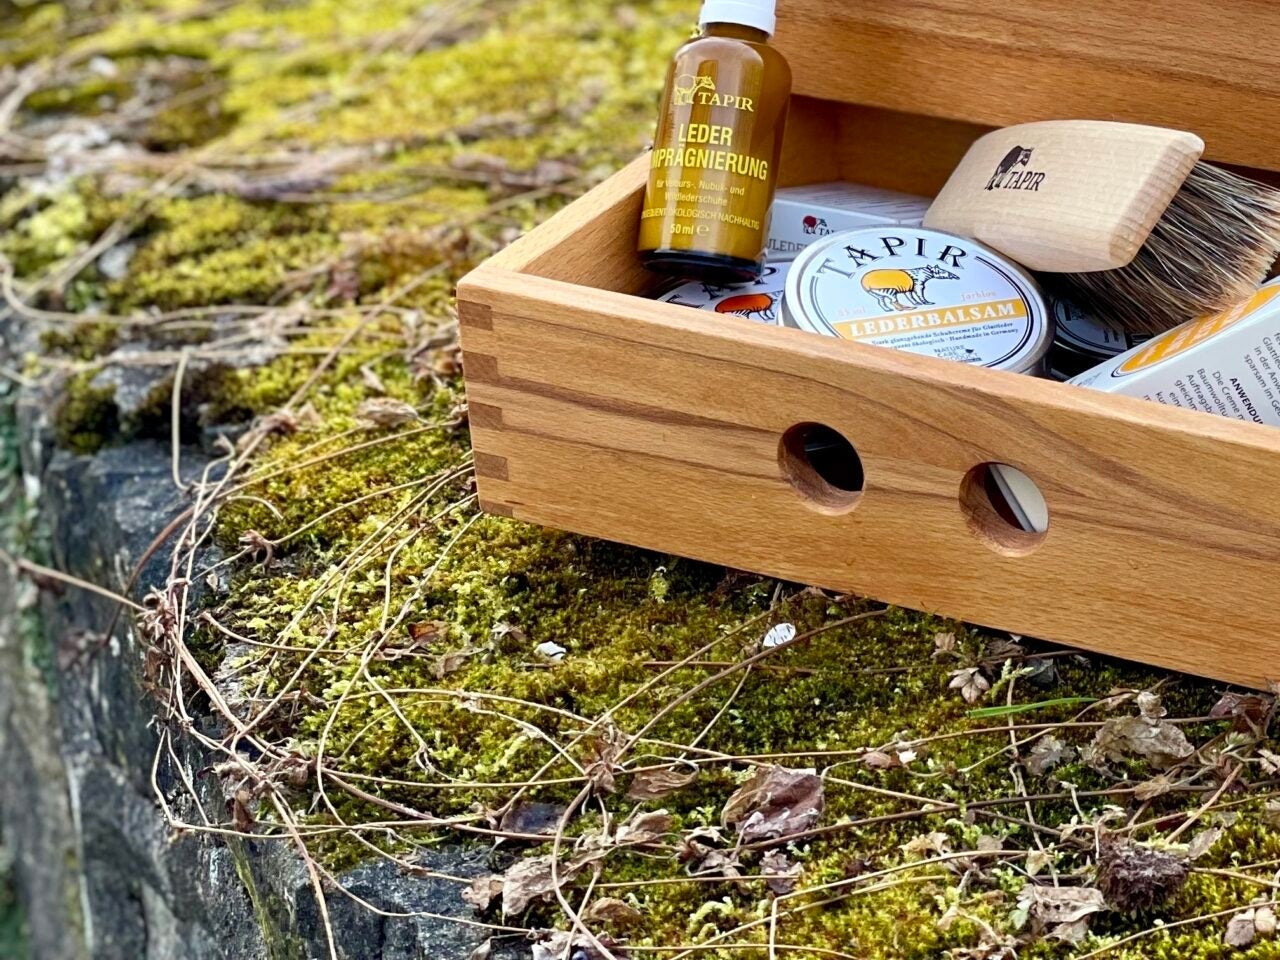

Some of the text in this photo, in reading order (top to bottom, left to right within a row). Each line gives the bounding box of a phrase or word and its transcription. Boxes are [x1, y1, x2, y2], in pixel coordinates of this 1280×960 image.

[698, 92, 754, 112] TAPIR
[678, 123, 733, 146] LEDER
[652, 144, 768, 180] MPRÄGNIERUNG
[698, 180, 728, 192] Nubuk-
[730, 184, 745, 196] und
[1003, 171, 1045, 191] TAPIR
[670, 223, 681, 234] 50
[682, 225, 694, 235] ml
[817, 236, 967, 280] TAPIR
[850, 303, 1015, 337] LEDERBALSAM
[991, 328, 1019, 336] Germany
[1253, 345, 1263, 355] in
[1258, 354, 1272, 371] der
[1196, 367, 1230, 419] Baumwolltu
[1211, 370, 1226, 387] Die
[1220, 385, 1241, 414] Creme
[1242, 353, 1267, 389] sparsam
[1263, 387, 1275, 399] im
[1174, 378, 1199, 412] gleichm
[1185, 373, 1213, 414] Auftragsb
[1229, 375, 1262, 427] ANWENDU
